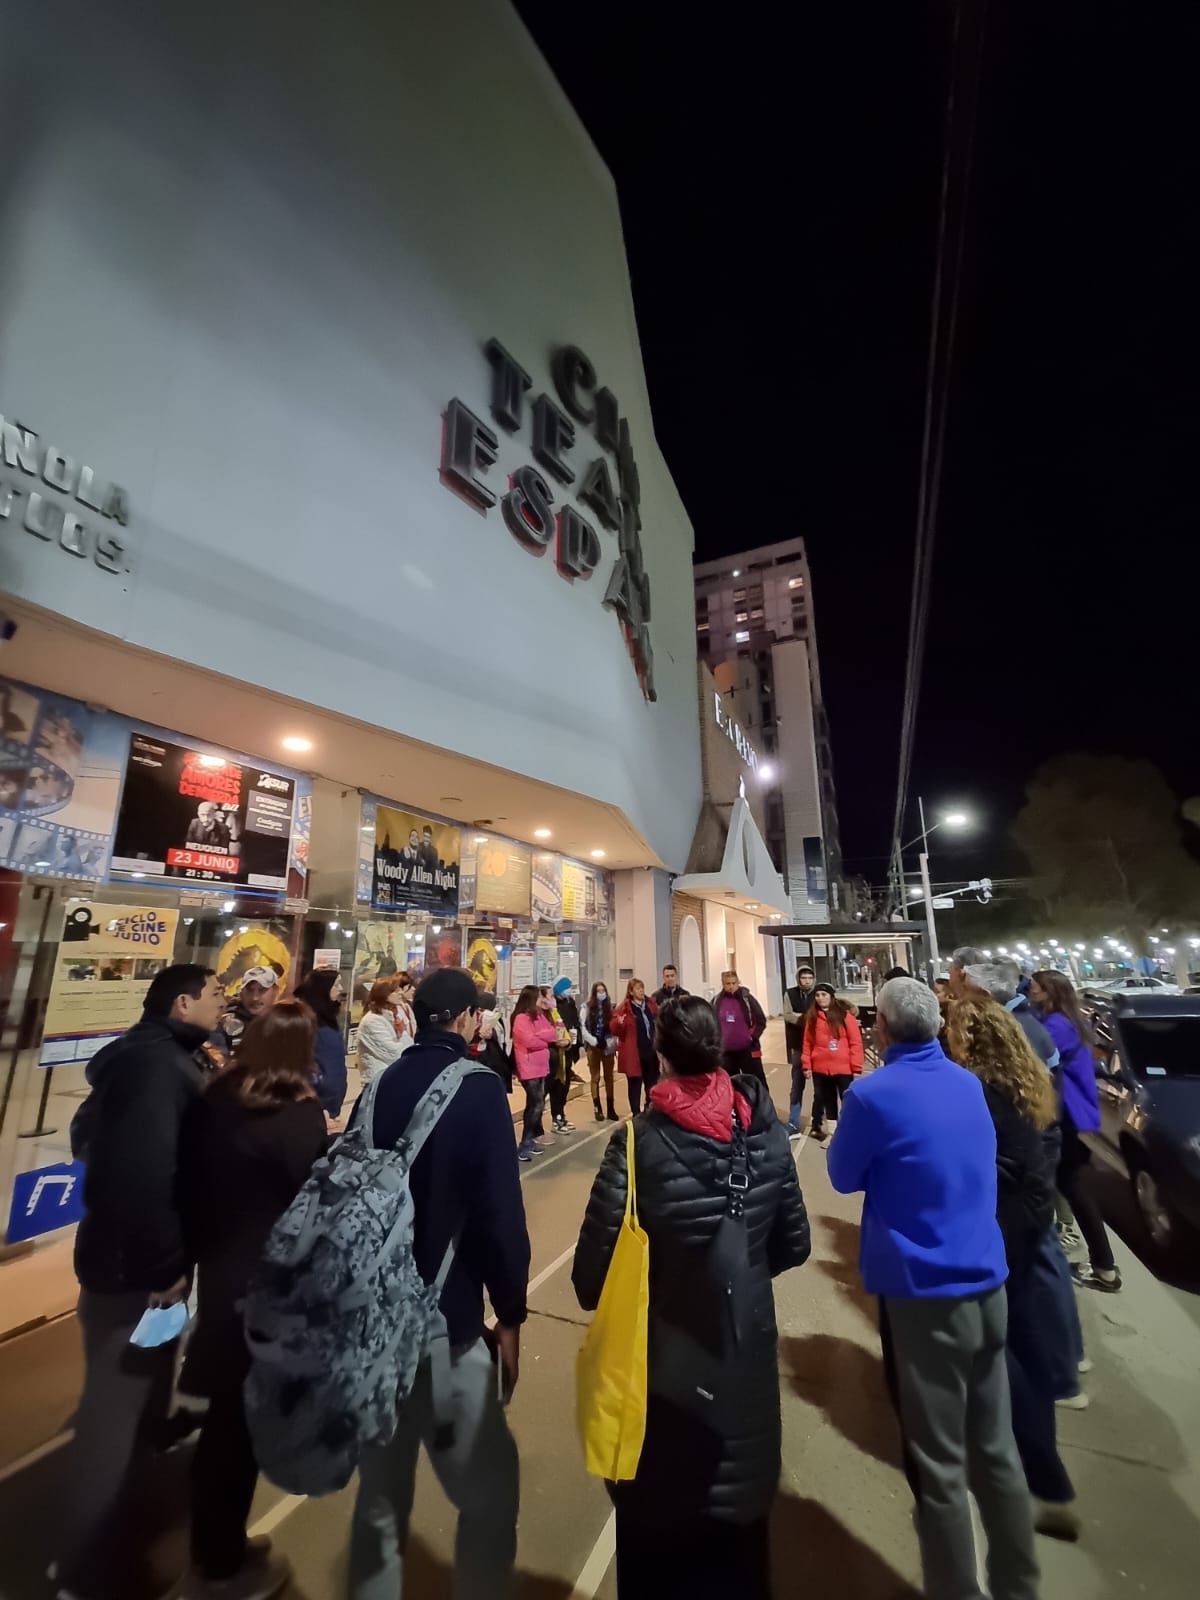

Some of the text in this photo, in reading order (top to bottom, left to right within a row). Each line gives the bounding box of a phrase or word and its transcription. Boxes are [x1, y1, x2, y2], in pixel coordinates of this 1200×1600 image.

[174, 852, 235, 870] 23 JUNIO
[376, 858, 408, 884] Woody
[410, 865, 433, 884] Allen
[434, 869, 457, 890] Night
[116, 911, 157, 925] CICLO
[131, 921, 167, 932] CINE
[113, 932, 160, 945] JUDIO
